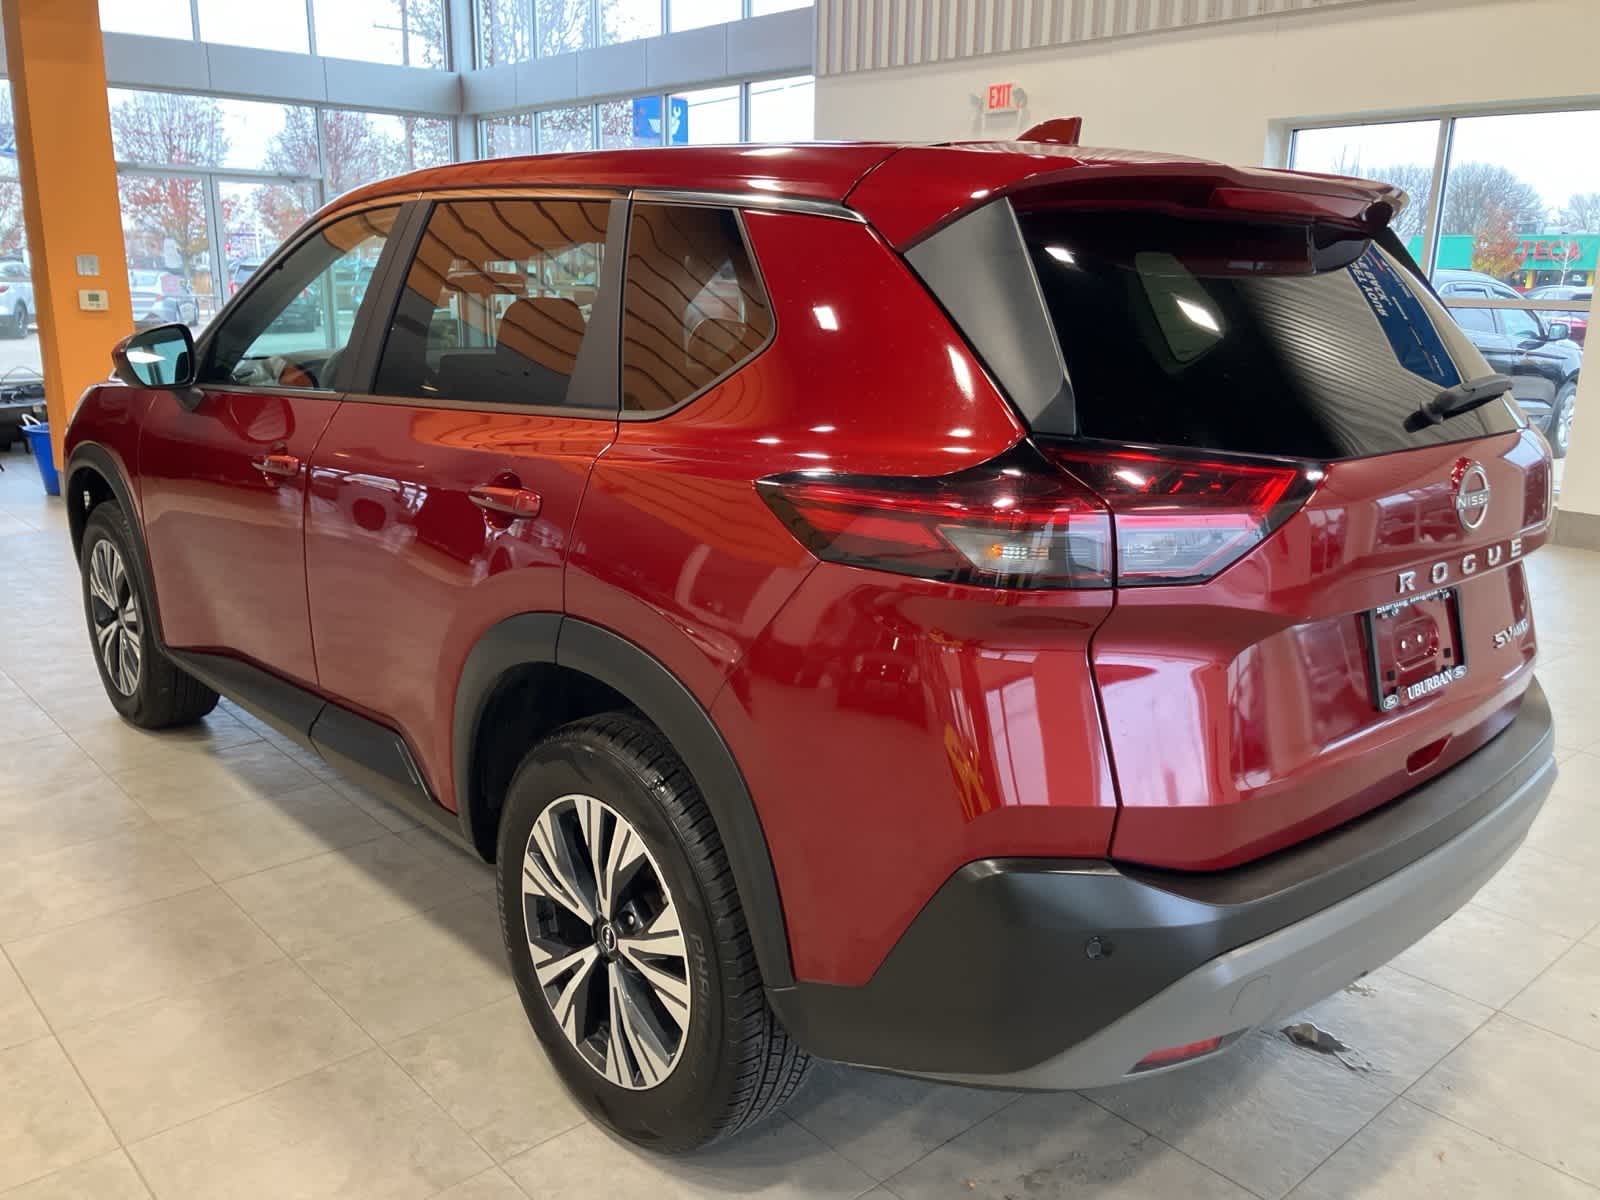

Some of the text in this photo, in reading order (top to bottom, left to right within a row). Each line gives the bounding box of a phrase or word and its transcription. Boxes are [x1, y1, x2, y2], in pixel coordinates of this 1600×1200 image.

[988, 83, 1013, 109] EXIT
[1397, 538, 1522, 594] ROGUE
[1493, 626, 1512, 649] SV
